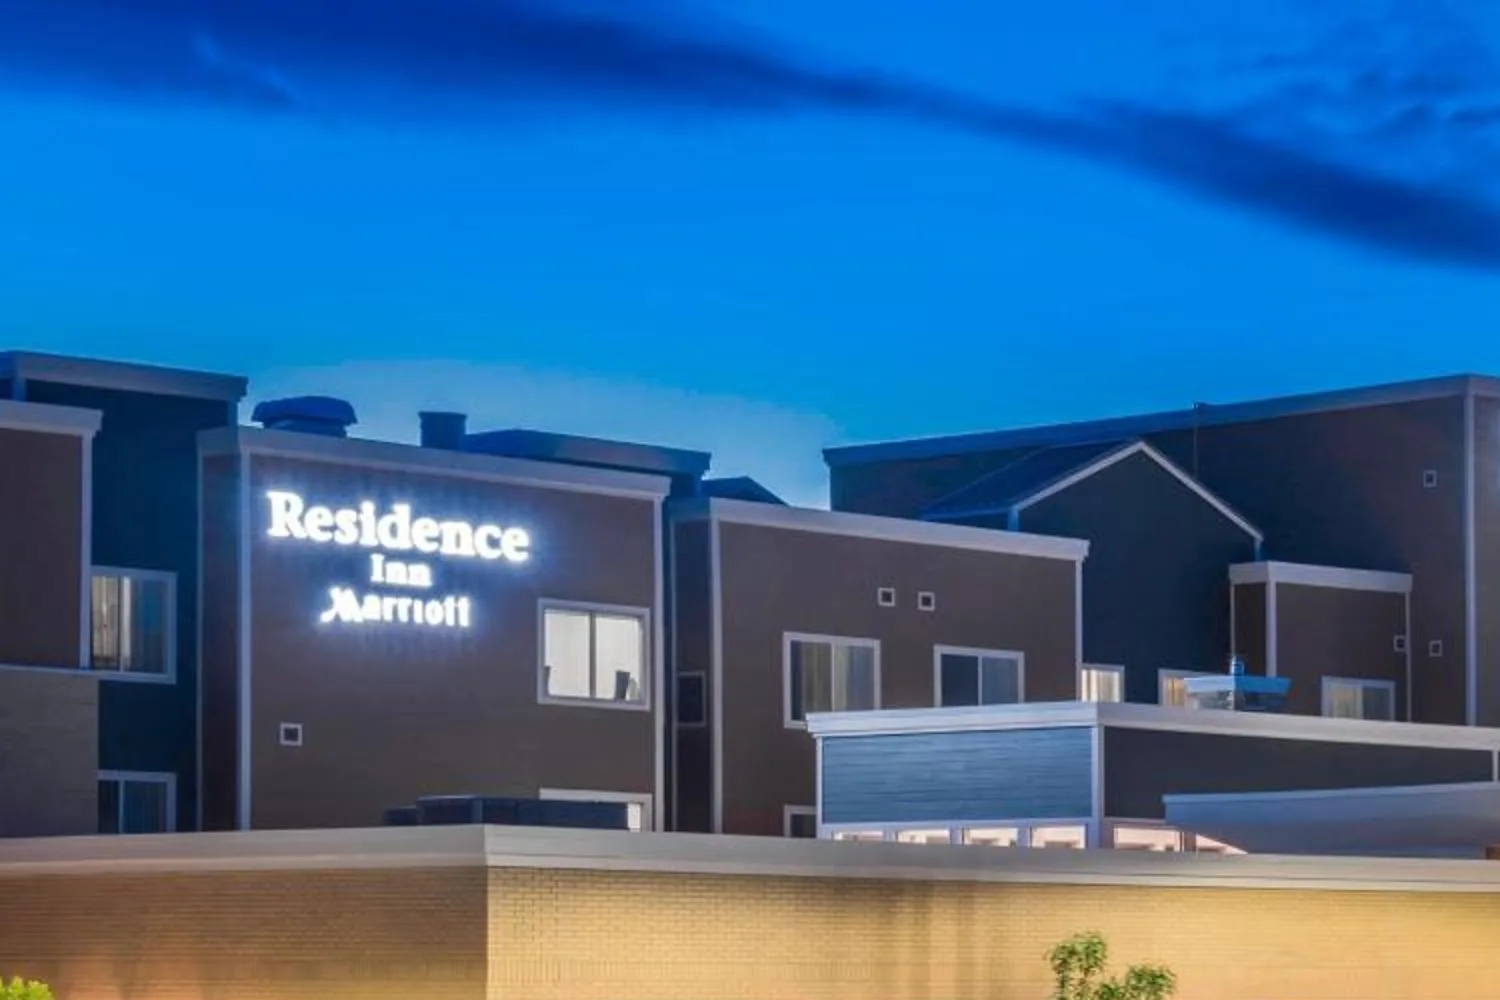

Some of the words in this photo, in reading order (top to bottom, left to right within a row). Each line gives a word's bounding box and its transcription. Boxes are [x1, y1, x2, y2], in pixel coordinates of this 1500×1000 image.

[266, 490, 531, 562] Residence
[369, 552, 433, 588] Inn
[319, 586, 471, 628] Marriott
